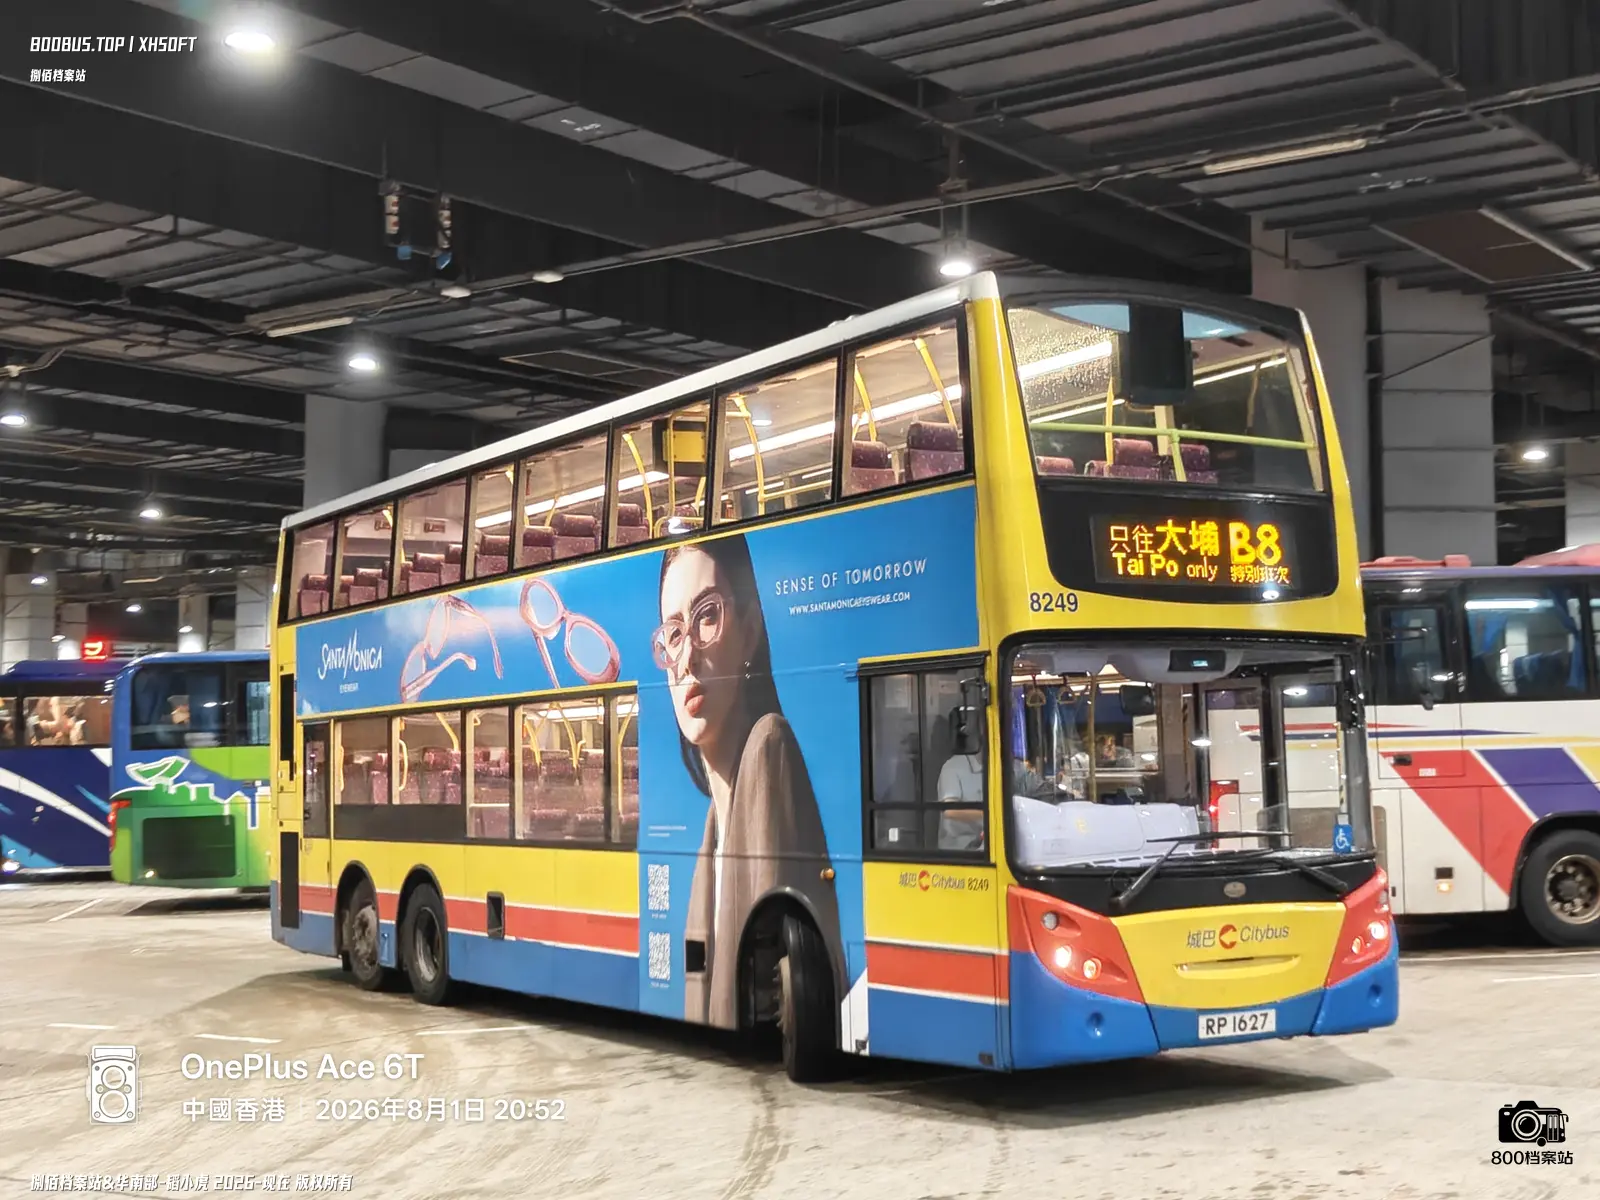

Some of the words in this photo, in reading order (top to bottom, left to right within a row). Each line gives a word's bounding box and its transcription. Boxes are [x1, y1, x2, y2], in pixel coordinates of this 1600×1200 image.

[1109, 518, 1220, 557] 只往大埔
[1228, 521, 1282, 566] B8
[775, 576, 815, 595] SENSE
[821, 572, 838, 588] OF
[845, 557, 928, 585] TOMORROW
[1111, 552, 1145, 577] Tai
[1150, 554, 1180, 577] Po
[1186, 556, 1218, 583] only
[788, 591, 911, 616] WWW.SANTAMONICAEYEWEAR.COM
[1029, 592, 1078, 612] 8249
[931, 873, 965, 890] Citybus
[967, 877, 989, 891] 8249
[1186, 929, 1216, 948] 城巴
[1240, 924, 1290, 942] Citybus
[1205, 1017, 1228, 1036] RP
[1232, 1012, 1269, 1033] 1627
